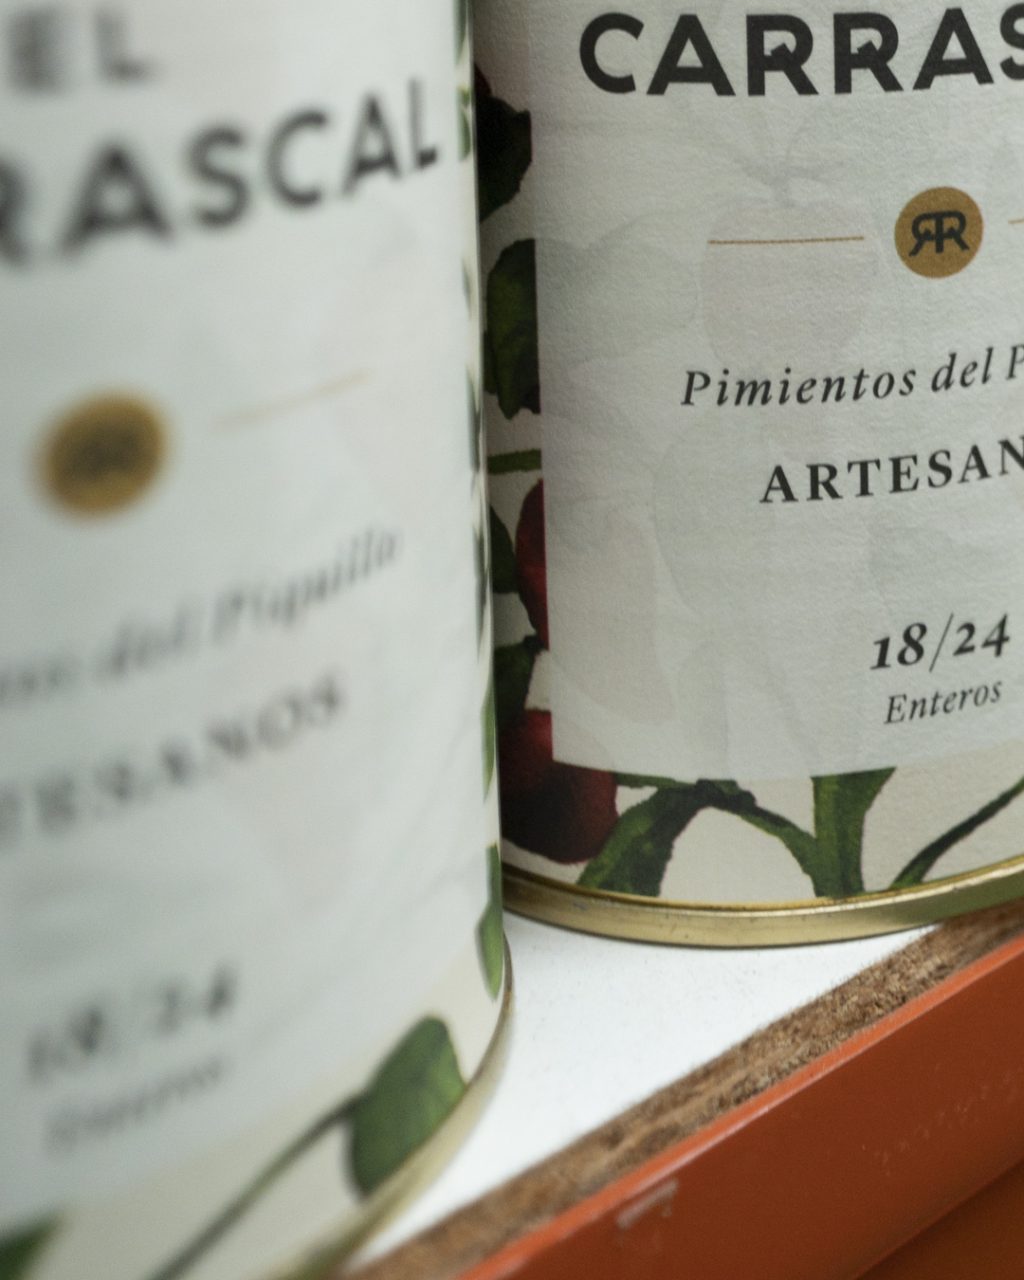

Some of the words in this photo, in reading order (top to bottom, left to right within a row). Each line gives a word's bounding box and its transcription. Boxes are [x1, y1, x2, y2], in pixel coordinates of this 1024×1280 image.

[8, 4, 154, 96] EL
[680, 366, 917, 408] Pimientos
[930, 346, 996, 394] del
[870, 613, 1011, 673] 18/24
[884, 679, 1003, 725] Enteros
